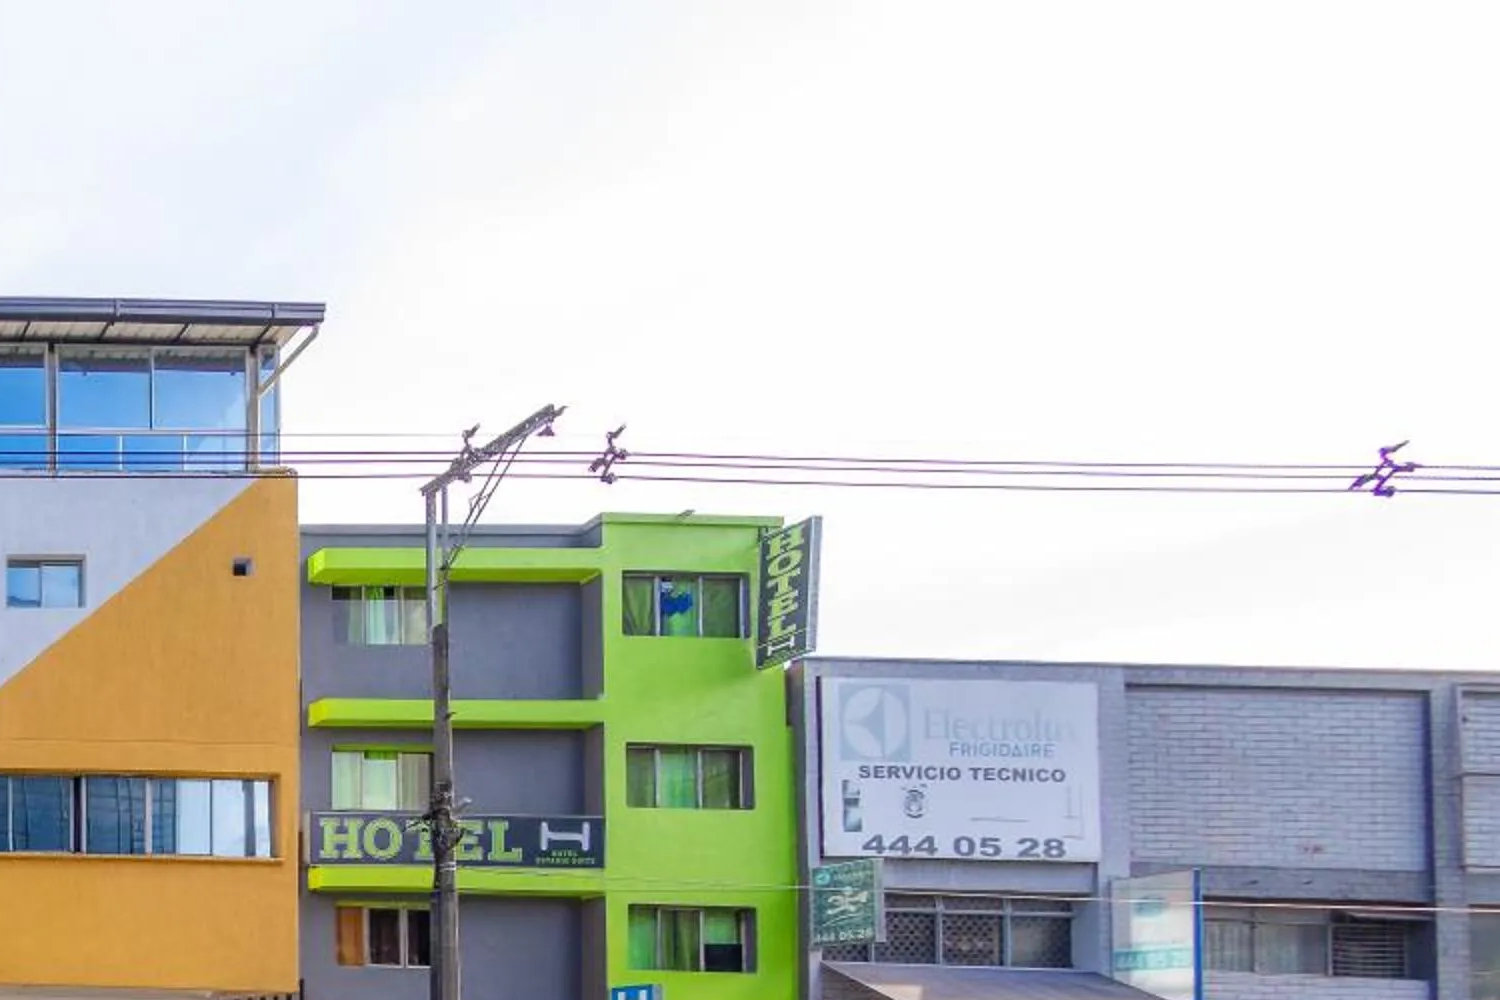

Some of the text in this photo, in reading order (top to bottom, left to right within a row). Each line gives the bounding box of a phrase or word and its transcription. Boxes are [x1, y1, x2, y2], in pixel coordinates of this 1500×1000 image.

[766, 524, 805, 644] HOTEL
[949, 741, 1055, 759] FRIGIDAIRE
[858, 765, 1066, 783] SERVICIO TECNICO
[319, 817, 523, 863] HOTEL
[862, 834, 1067, 858] 444 05 28
